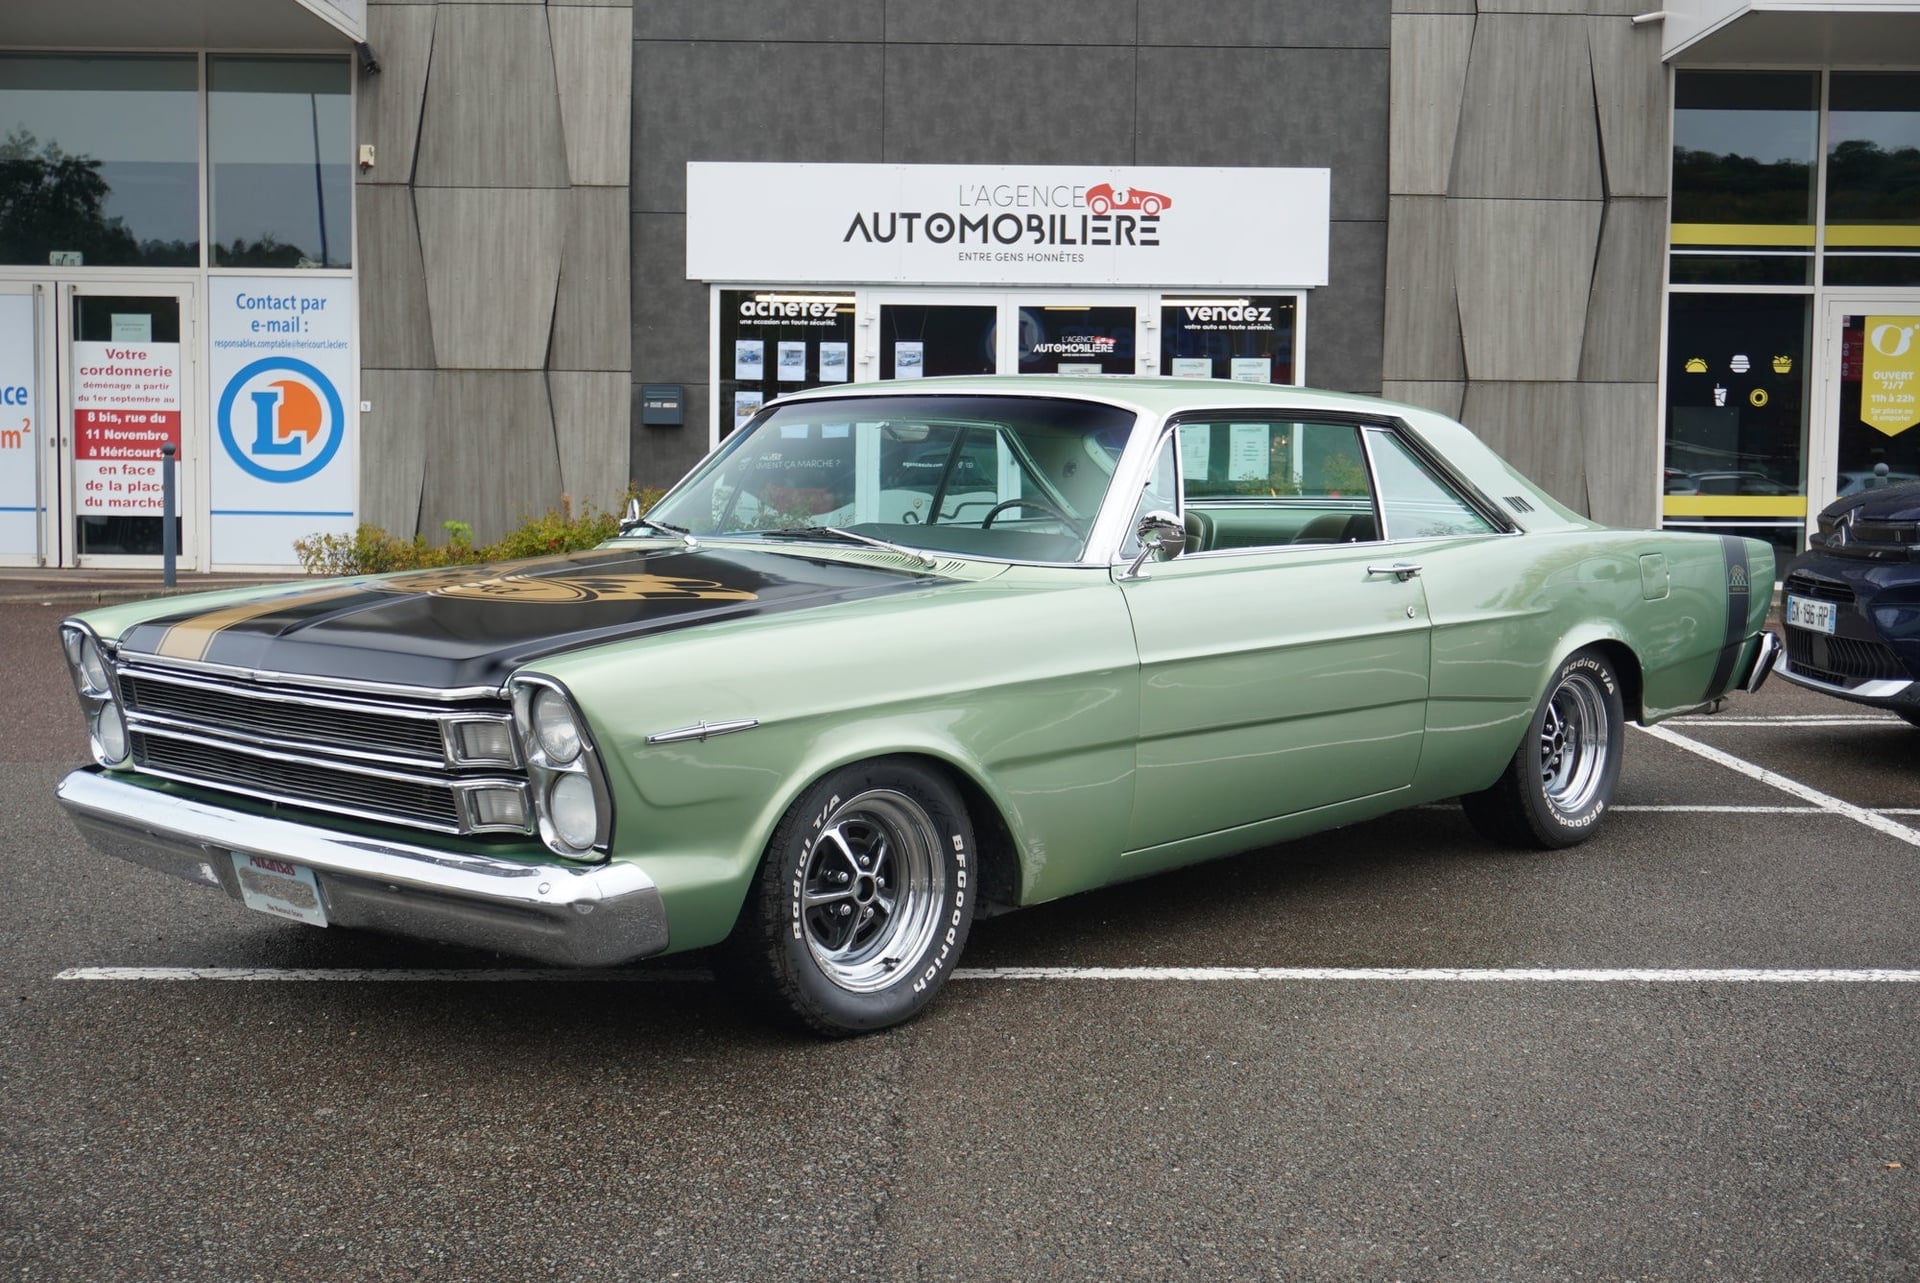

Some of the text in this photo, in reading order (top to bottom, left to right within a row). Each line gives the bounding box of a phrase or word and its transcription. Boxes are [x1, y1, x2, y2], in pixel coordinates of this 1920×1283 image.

[959, 184, 1086, 208] L'AGENCE
[1116, 191, 1123, 202] 1
[843, 211, 1160, 246] AUTOMOBILIERE
[959, 250, 1085, 263] ENTRE GENS HONNÊTES
[236, 293, 327, 314] Contact par
[740, 294, 838, 317] achetez
[1184, 299, 1272, 322] vendez
[251, 316, 300, 333] e-mail
[105, 348, 147, 360] Votre
[1033, 343, 1114, 353] AUTOMOBILIERE
[80, 365, 173, 377] cordonnerie
[1872, 370, 1915, 380] OUVERT
[143, 383, 170, 391] partir
[0, 386, 28, 405] ce
[78, 394, 90, 402] du
[93, 394, 107, 402] 1er
[110, 395, 160, 404] septembre
[87, 412, 166, 425] 8 bis, rue du
[86, 429, 169, 441] 11 Novembre
[89, 446, 97, 457] à
[99, 464, 156, 475] en face
[85, 480, 103, 491] de
[109, 480, 122, 491] la
[85, 497, 103, 508] du
[813, 795, 840, 829] T/A
[912, 834, 967, 993] BFGoodrich
